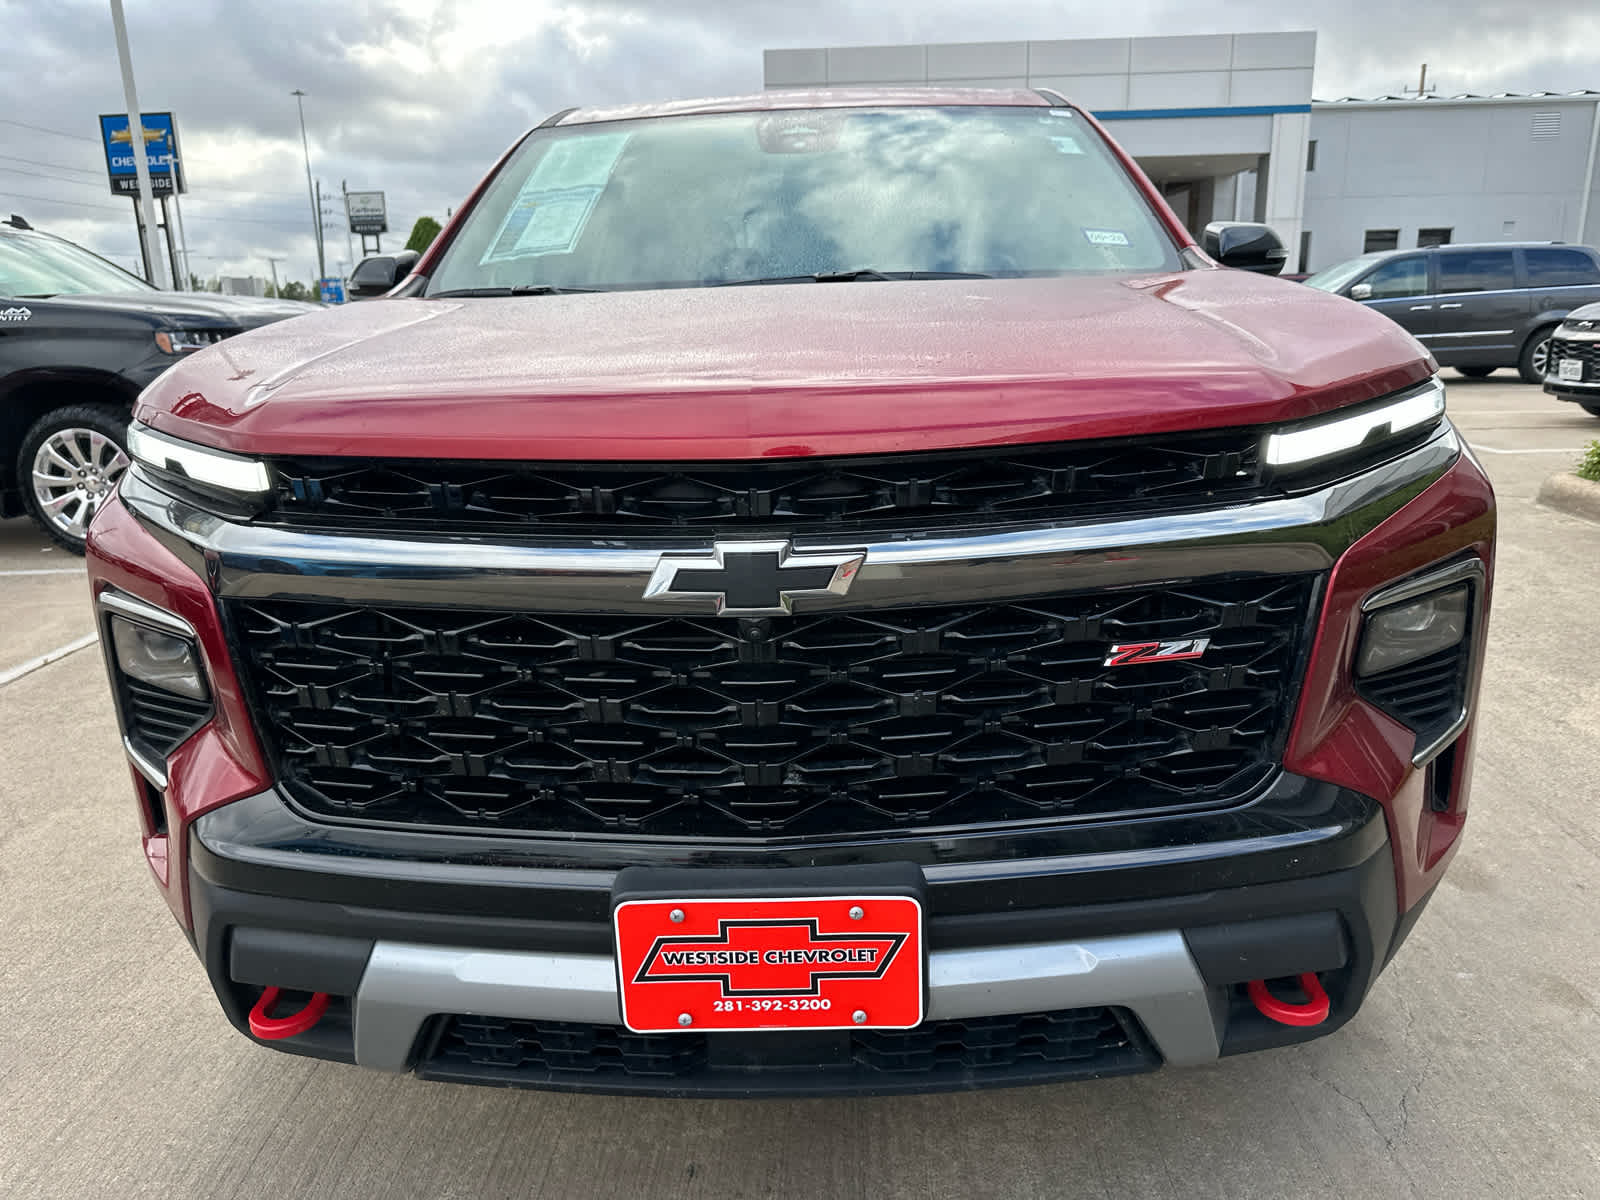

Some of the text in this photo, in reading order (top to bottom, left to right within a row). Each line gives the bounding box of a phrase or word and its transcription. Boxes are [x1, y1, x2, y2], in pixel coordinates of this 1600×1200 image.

[662, 948, 879, 965] WESTSIDE CHEVROLET
[713, 999, 831, 1012] 281-392-3200
